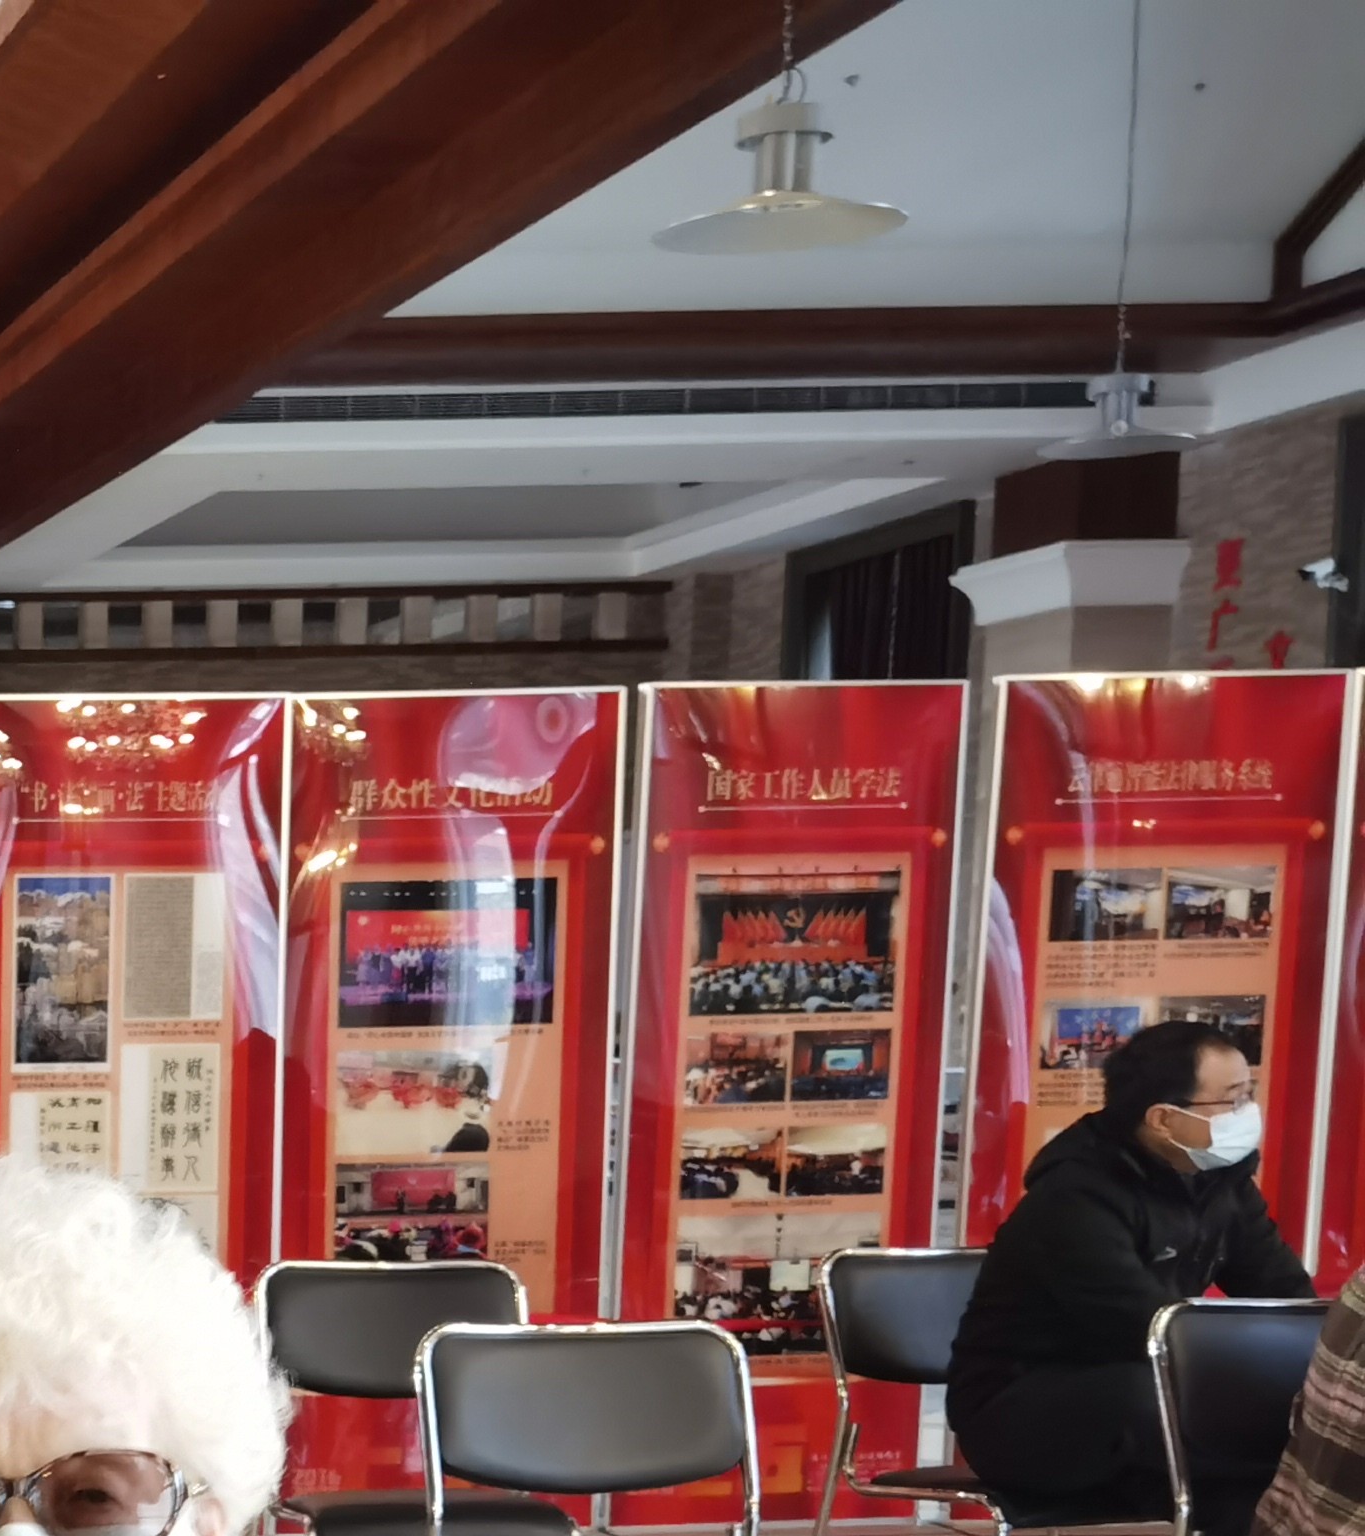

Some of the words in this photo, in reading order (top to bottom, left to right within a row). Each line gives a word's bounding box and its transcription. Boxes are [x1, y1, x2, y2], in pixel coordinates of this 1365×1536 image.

[706, 766, 902, 801] 国家工作人员学法
